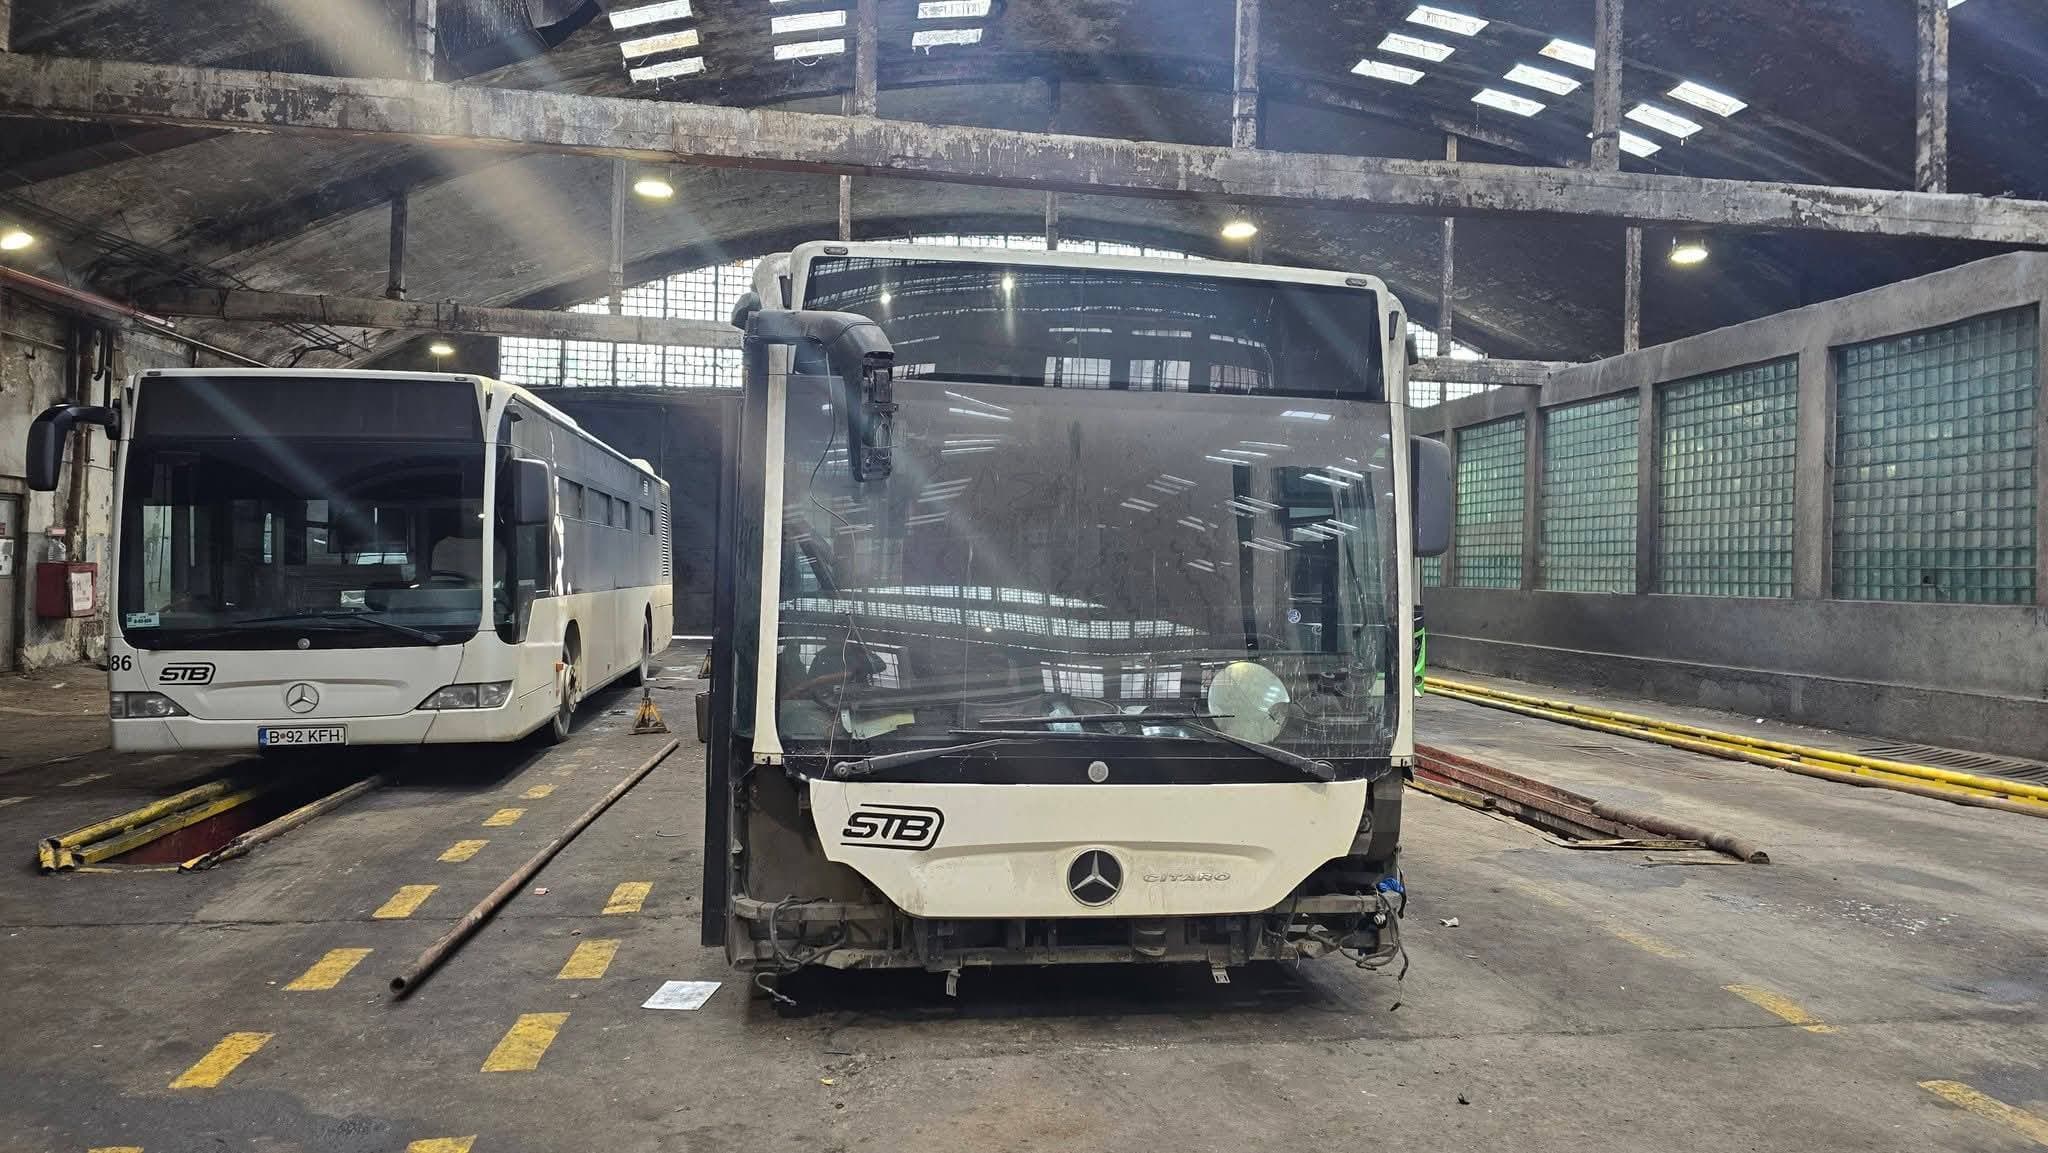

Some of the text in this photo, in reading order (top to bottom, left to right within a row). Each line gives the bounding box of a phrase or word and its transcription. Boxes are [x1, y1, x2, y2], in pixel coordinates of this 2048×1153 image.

[107, 655, 132, 671] 86
[159, 667, 210, 681] STB
[269, 731, 280, 744] B
[287, 731, 303, 743] 92
[308, 729, 340, 743] KFH
[842, 811, 935, 842] STB
[1143, 872, 1232, 884] CITARO
